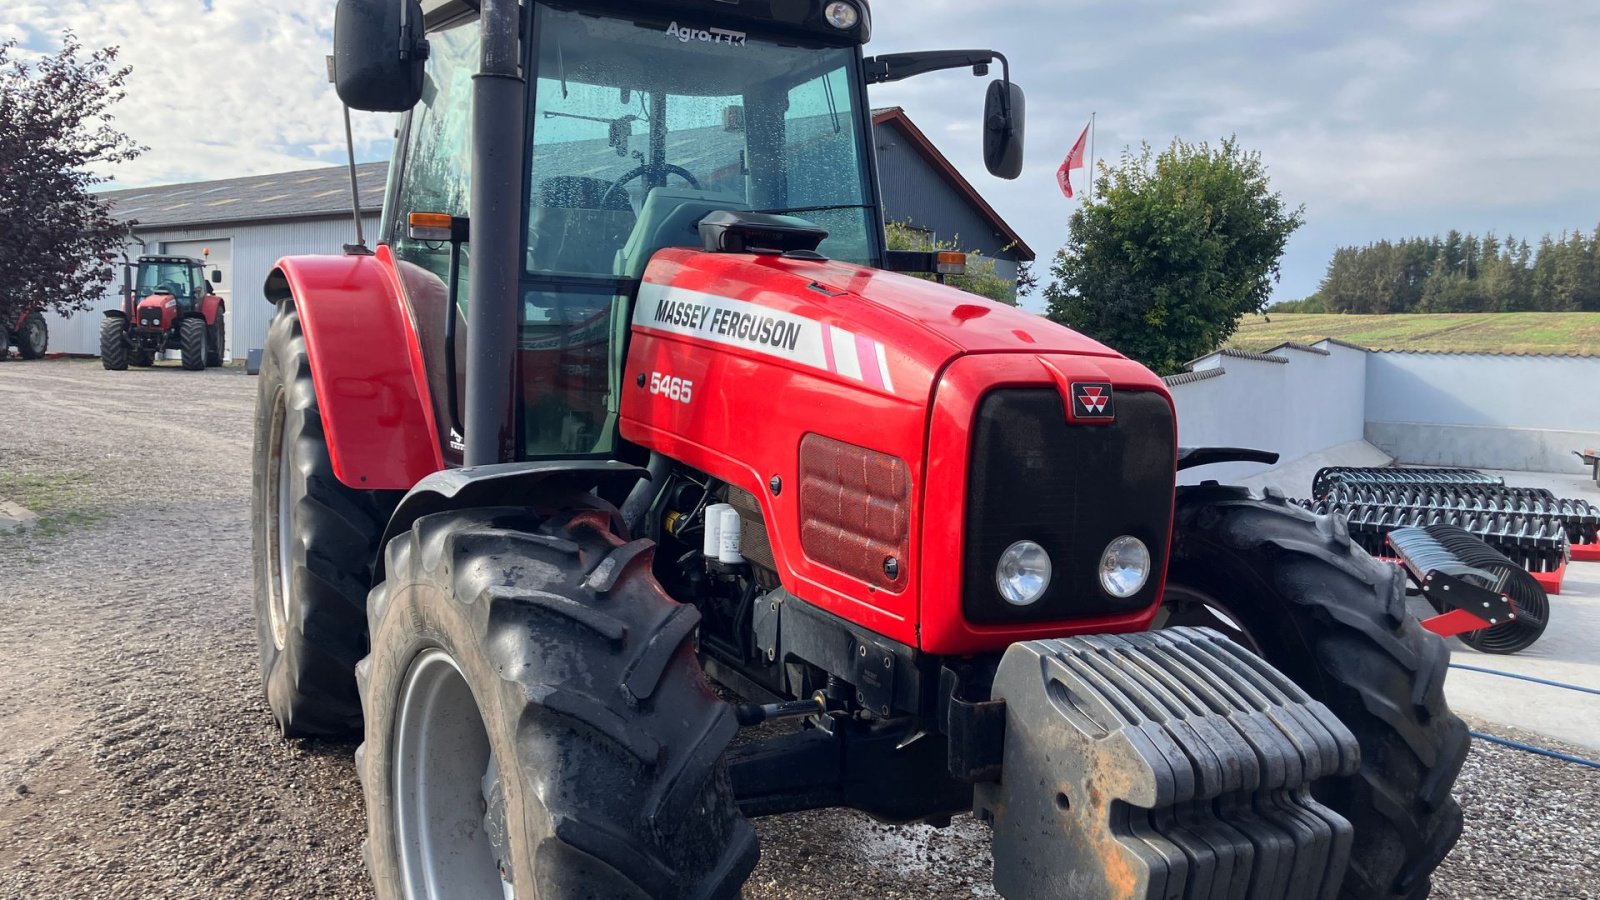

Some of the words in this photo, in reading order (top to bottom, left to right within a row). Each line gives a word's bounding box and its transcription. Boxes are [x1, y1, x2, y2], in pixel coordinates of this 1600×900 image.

[665, 20, 747, 47] AgroTEK
[654, 299, 711, 330] MASSEY
[709, 308, 802, 351] FERGUSON
[649, 371, 693, 404] 5465
